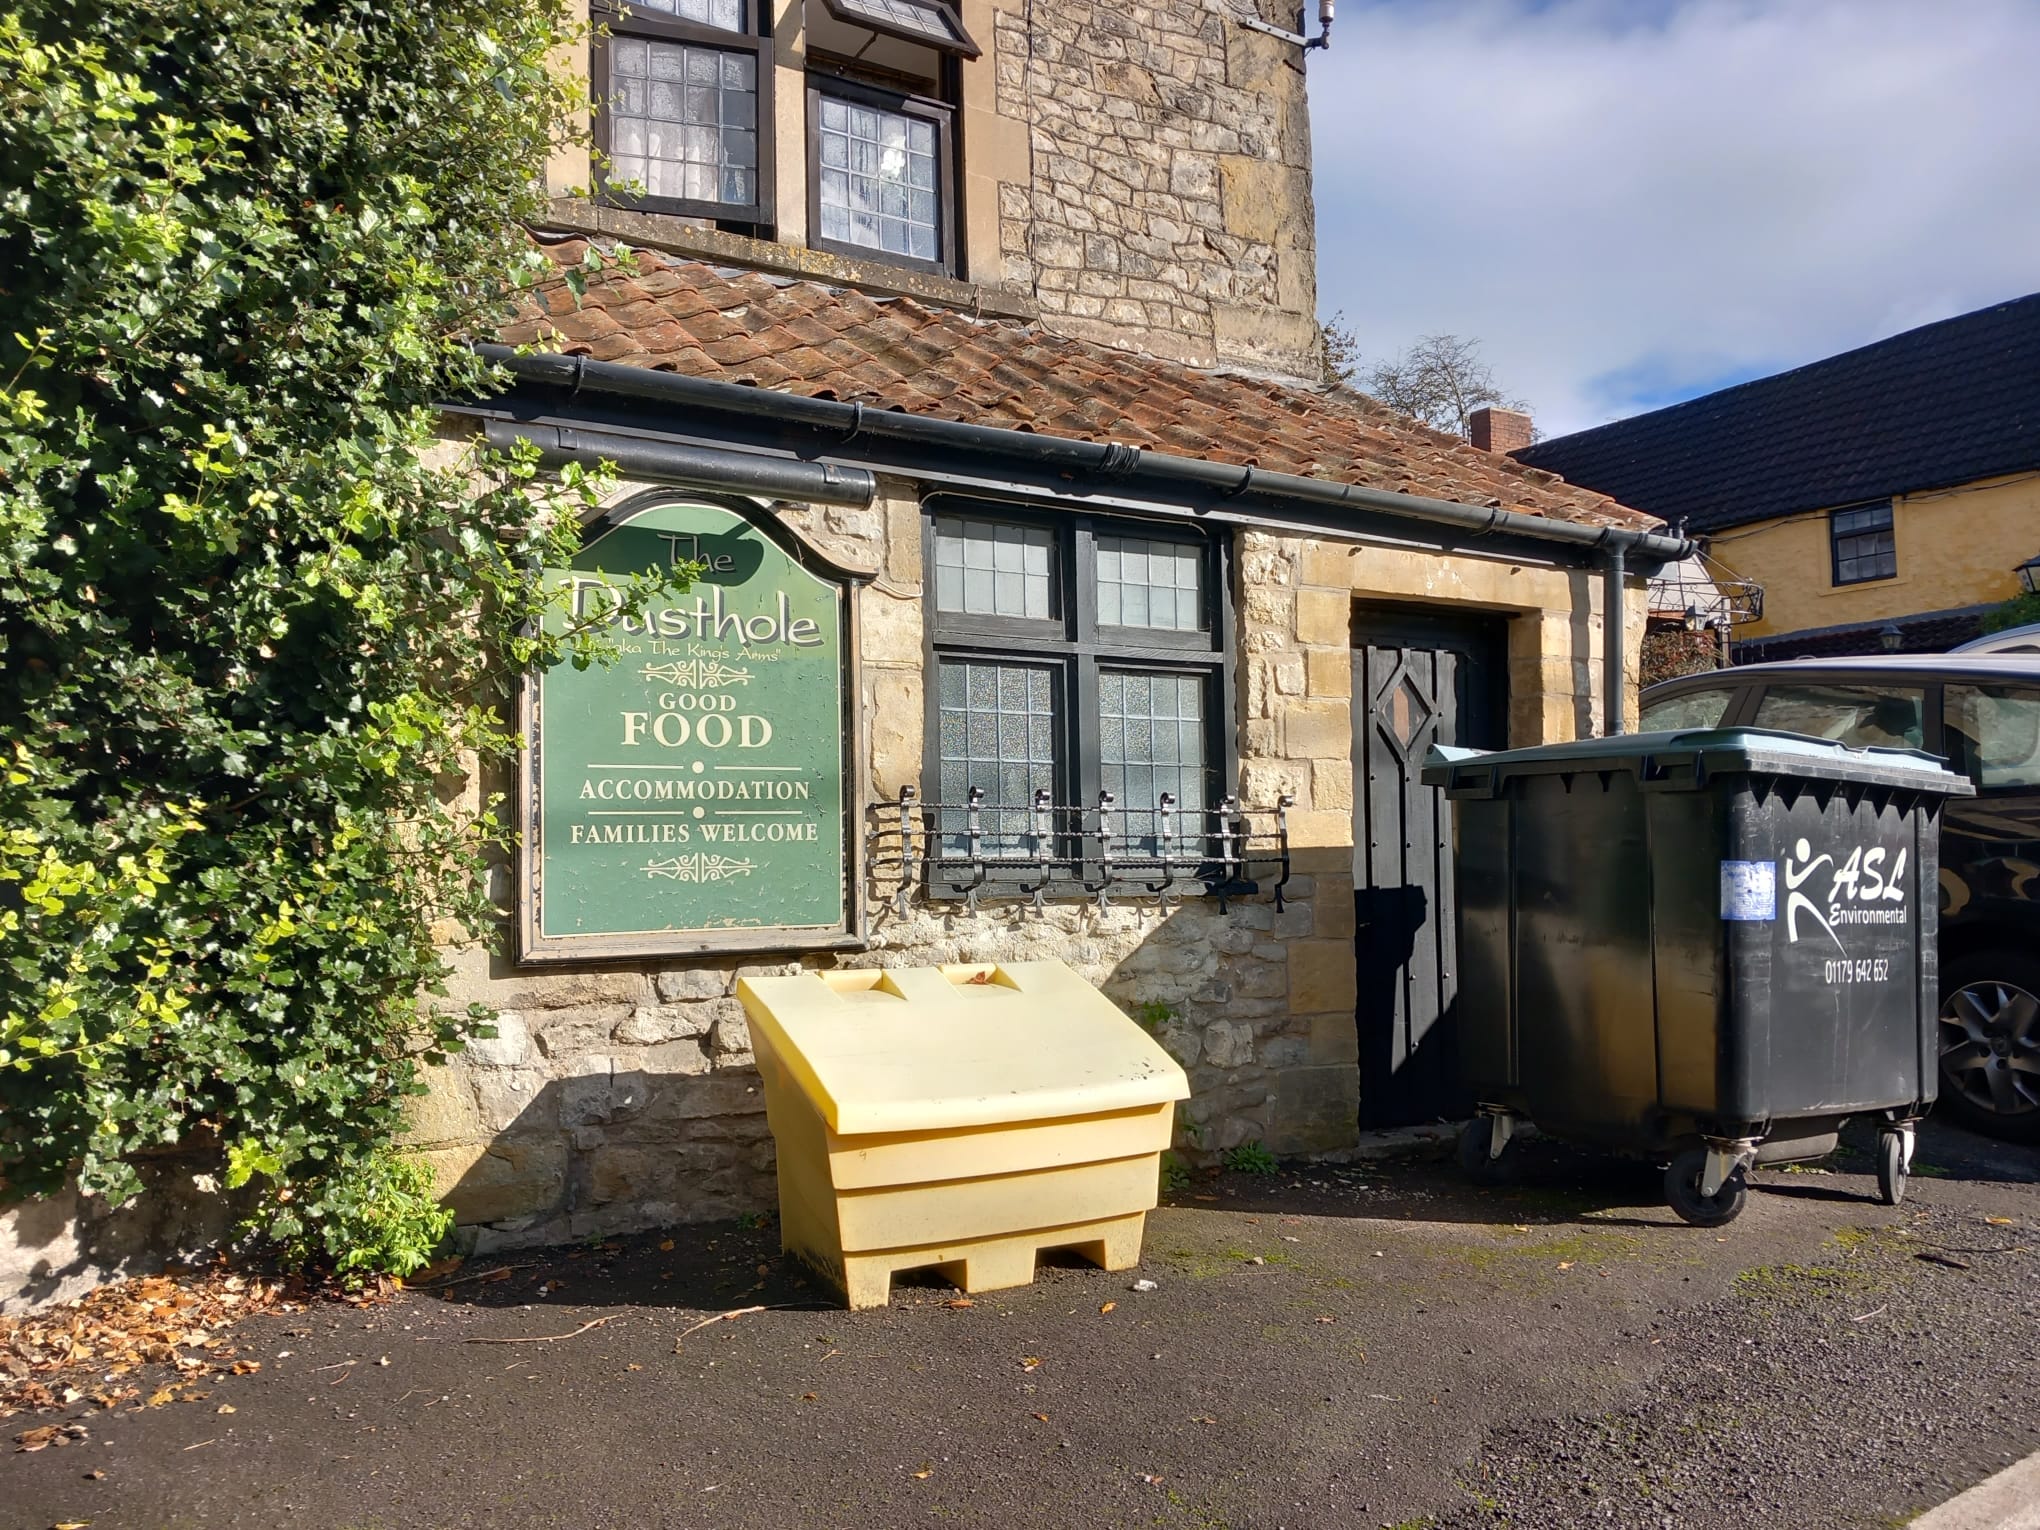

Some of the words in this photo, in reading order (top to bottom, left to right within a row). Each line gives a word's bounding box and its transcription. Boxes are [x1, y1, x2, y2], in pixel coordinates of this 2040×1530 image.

[656, 533, 736, 573] The
[558, 575, 825, 648] Dusthole
[648, 639, 681, 657] The
[687, 643, 731, 661] King's
[735, 646, 782, 662] Arms"
[659, 692, 737, 711] GOOD
[621, 711, 772, 748] FOOD
[579, 779, 810, 801] ACCOMMODATION
[570, 824, 690, 844] FAMILIES
[699, 823, 818, 842] WELCOME
[1828, 845, 1907, 903] ASL
[1829, 903, 1907, 926] Environmental
[1825, 958, 1853, 984] 01179
[1855, 958, 1872, 983] 642
[1873, 958, 1889, 983] 652
